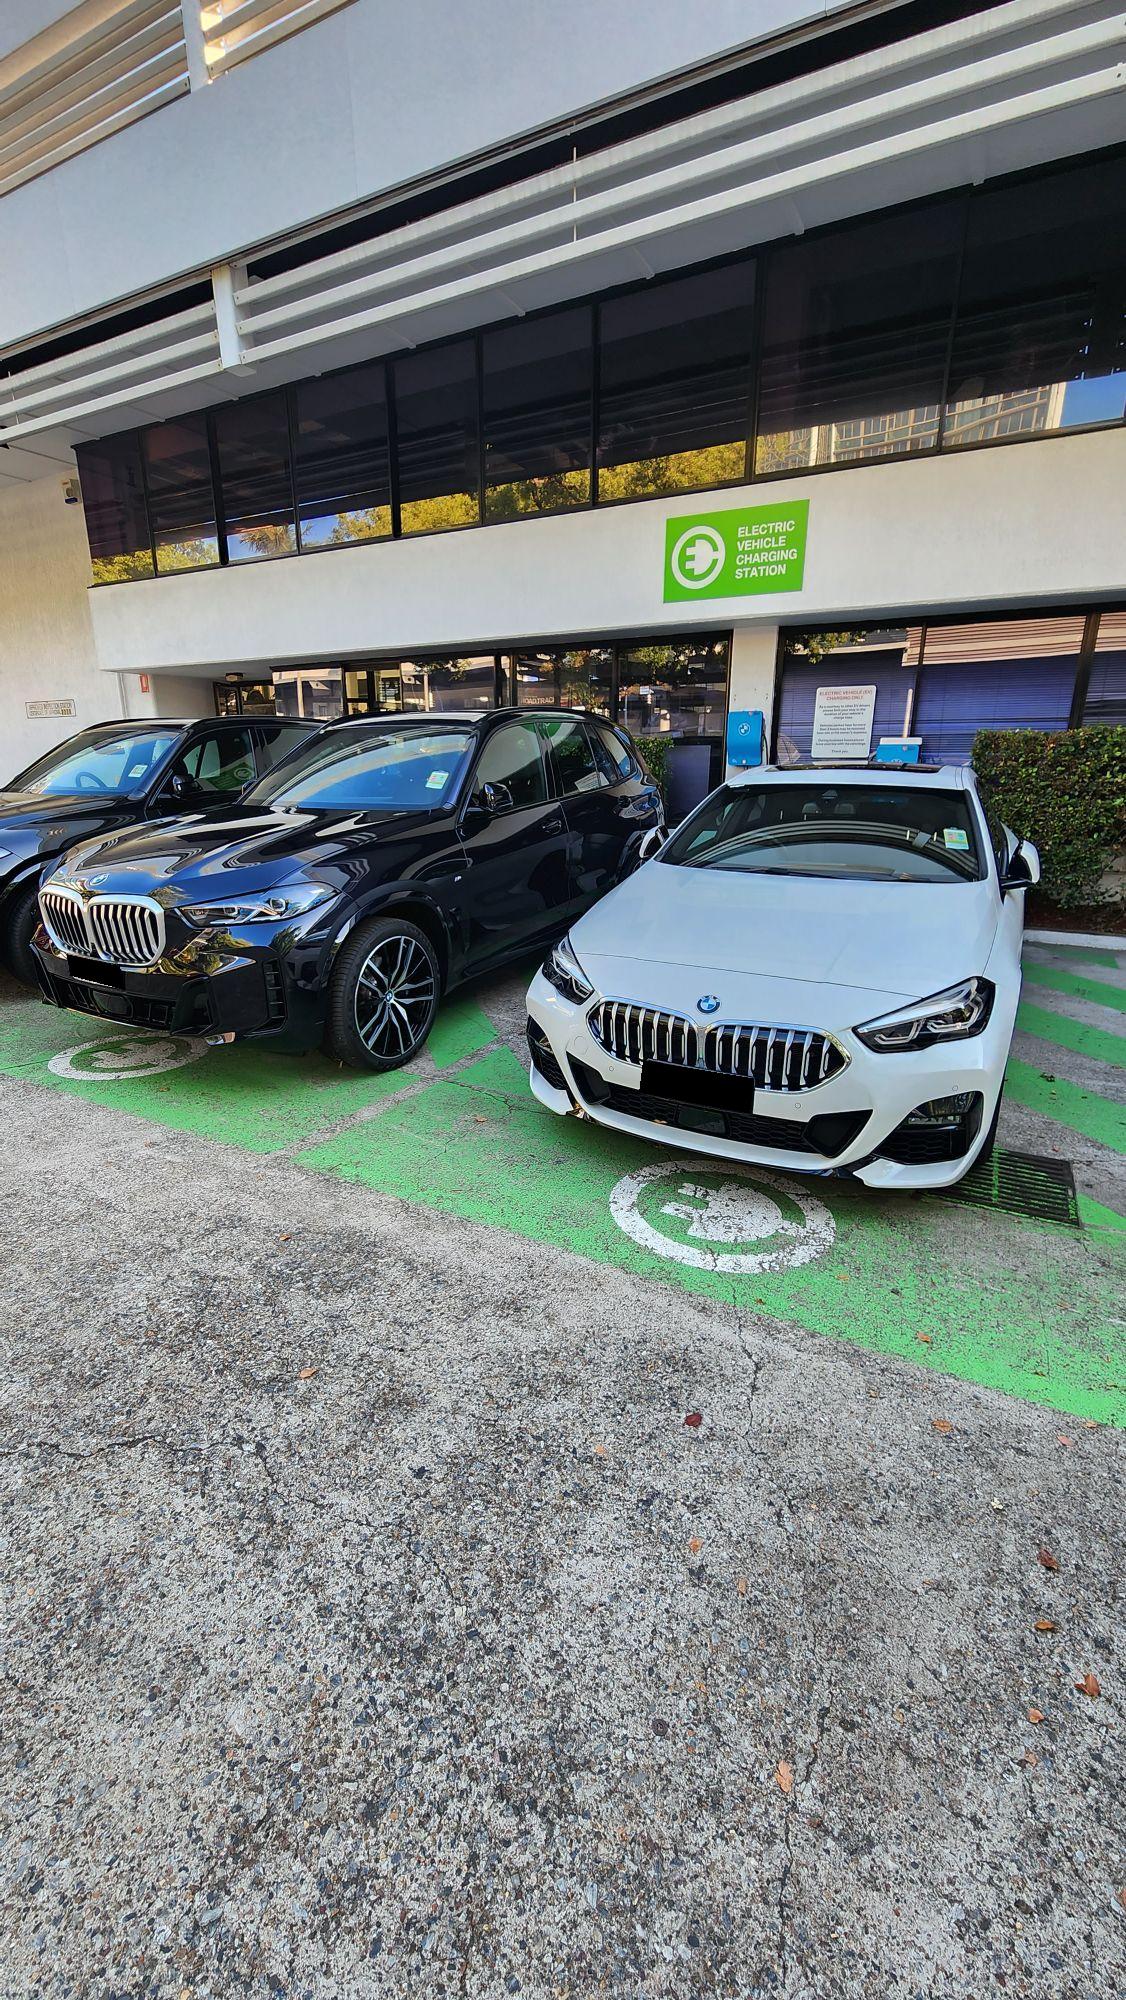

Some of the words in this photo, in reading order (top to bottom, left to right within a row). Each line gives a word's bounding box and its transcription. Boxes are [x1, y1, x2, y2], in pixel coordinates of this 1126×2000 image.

[738, 520, 795, 538] ELECTRIC
[736, 535, 787, 552] VEHICLE
[735, 548, 798, 566] CHARGING
[734, 563, 787, 579] STATION
